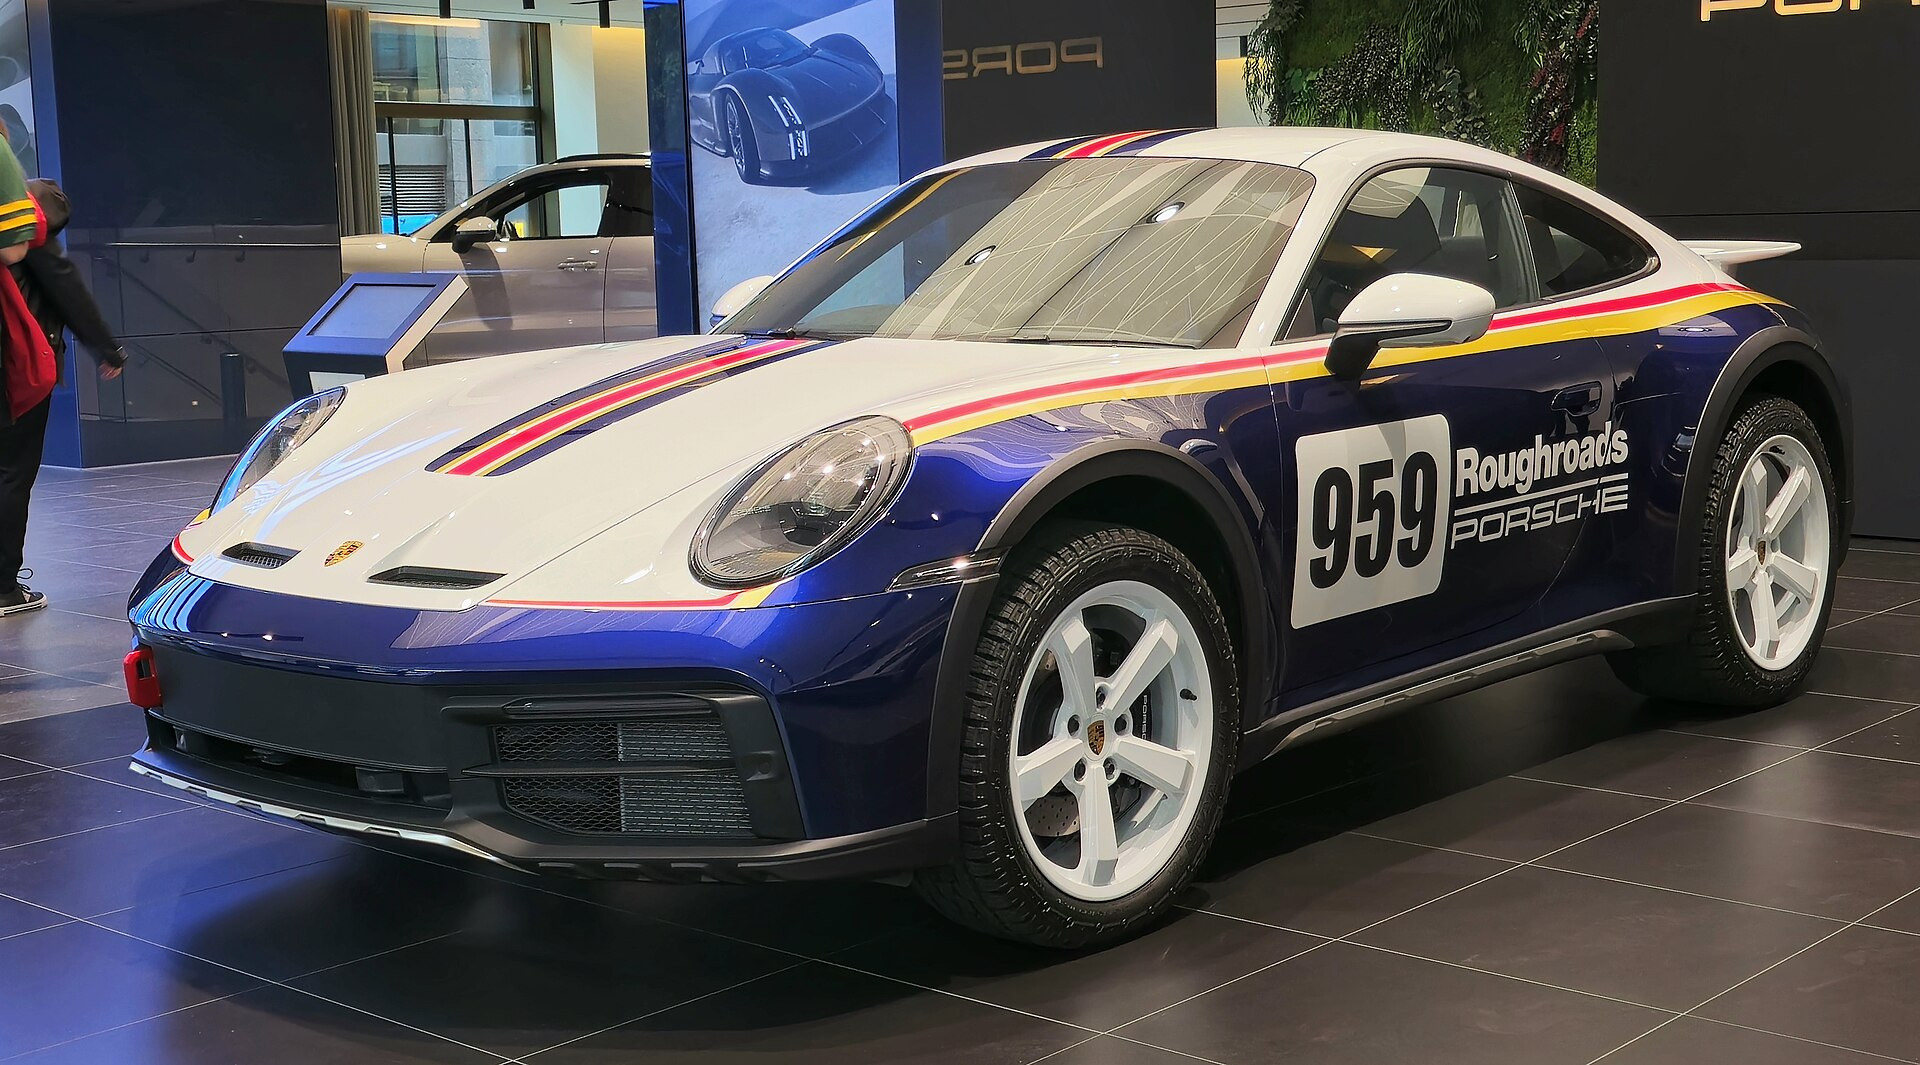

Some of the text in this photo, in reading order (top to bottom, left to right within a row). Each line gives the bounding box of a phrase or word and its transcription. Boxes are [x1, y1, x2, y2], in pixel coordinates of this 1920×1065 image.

[1455, 421, 1629, 497] Roughroads
[1310, 451, 1437, 589] 959
[1450, 485, 1629, 550] PORSCHE
